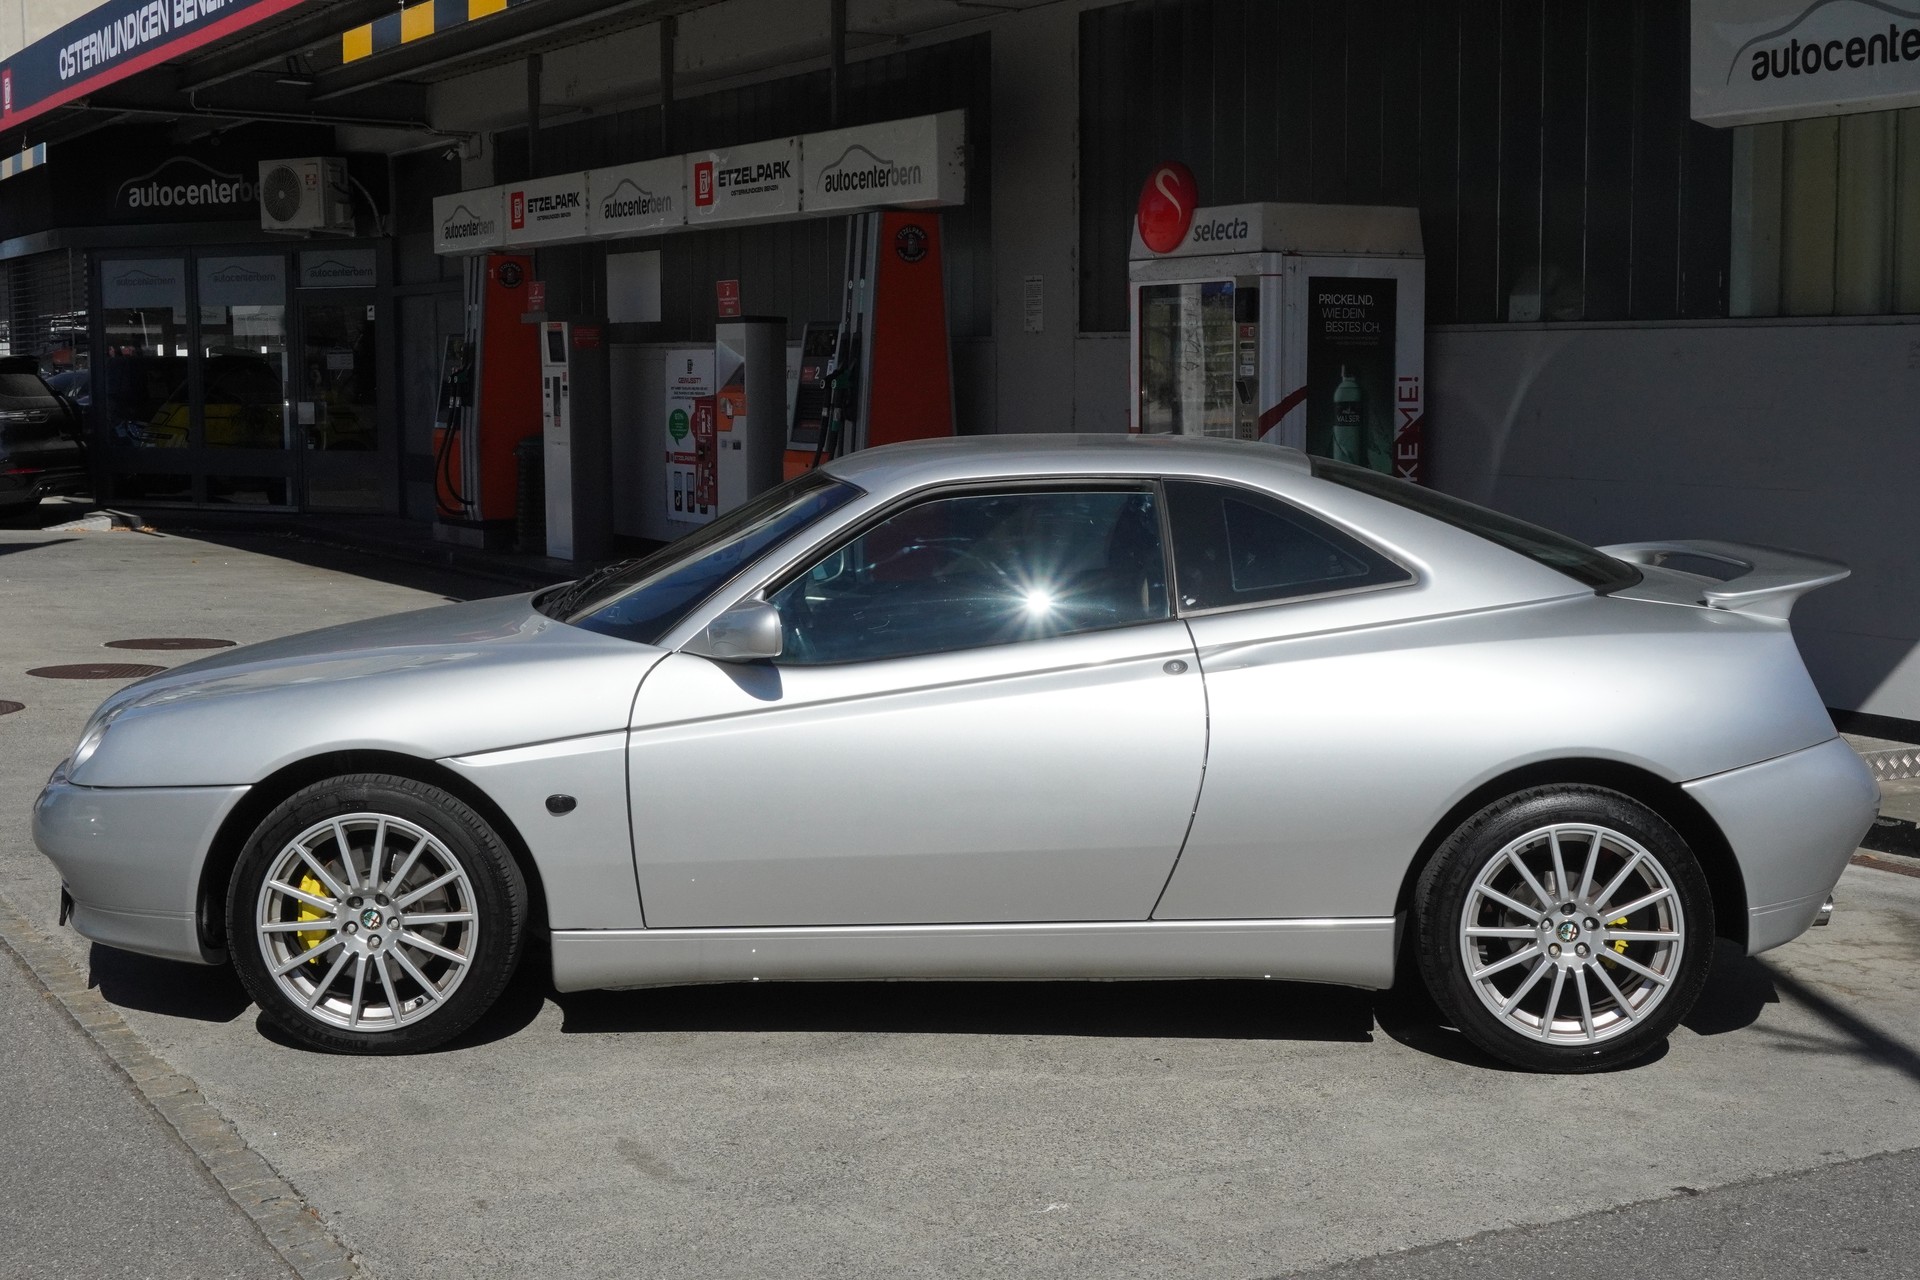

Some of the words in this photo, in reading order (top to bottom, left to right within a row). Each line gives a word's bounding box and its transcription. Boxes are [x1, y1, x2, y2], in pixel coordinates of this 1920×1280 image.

[59, 0, 170, 80] OSTERMUNDIGEN
[1751, 23, 1920, 81] autocente
[718, 160, 791, 187] ETZELPARK
[824, 162, 921, 193] autocenterbern
[527, 191, 580, 213] ETZELPARK
[604, 194, 672, 220] autocenterbern
[444, 219, 495, 240] autocenterbern
[1193, 217, 1248, 242] selecta
[310, 266, 373, 278] autocenterbern
[1318, 293, 1374, 306] PRICKELND,
[1322, 308, 1341, 319] WIE
[1342, 308, 1366, 319] DEIN
[1325, 321, 1361, 332] BESTES
[1362, 321, 1381, 333] ICH.
[814, 366, 821, 379] 2
[1398, 376, 1419, 433] ME!
[1337, 415, 1361, 423] VALSER
